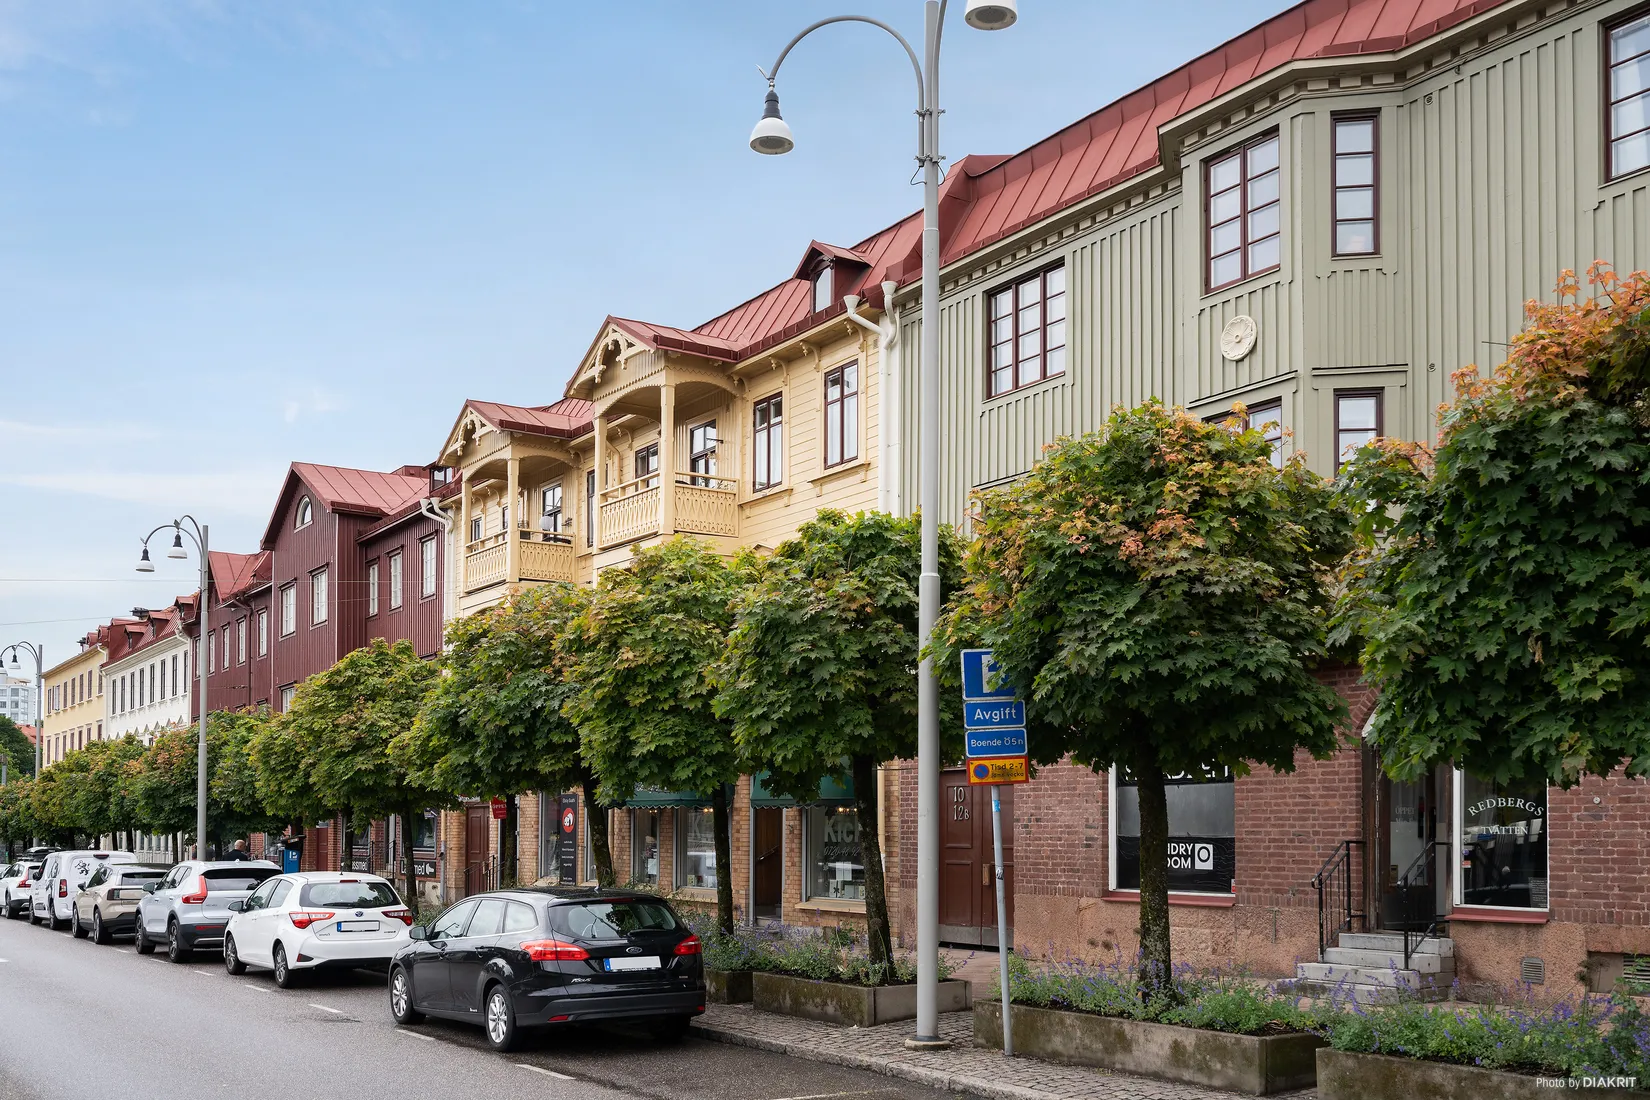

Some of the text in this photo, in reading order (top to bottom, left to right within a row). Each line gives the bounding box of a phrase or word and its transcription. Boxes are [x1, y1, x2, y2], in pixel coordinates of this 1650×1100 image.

[974, 705, 1016, 722] Avgift
[971, 738, 1002, 747] Boende
[953, 786, 966, 803] 10
[1467, 797, 1545, 817] REDBERGS
